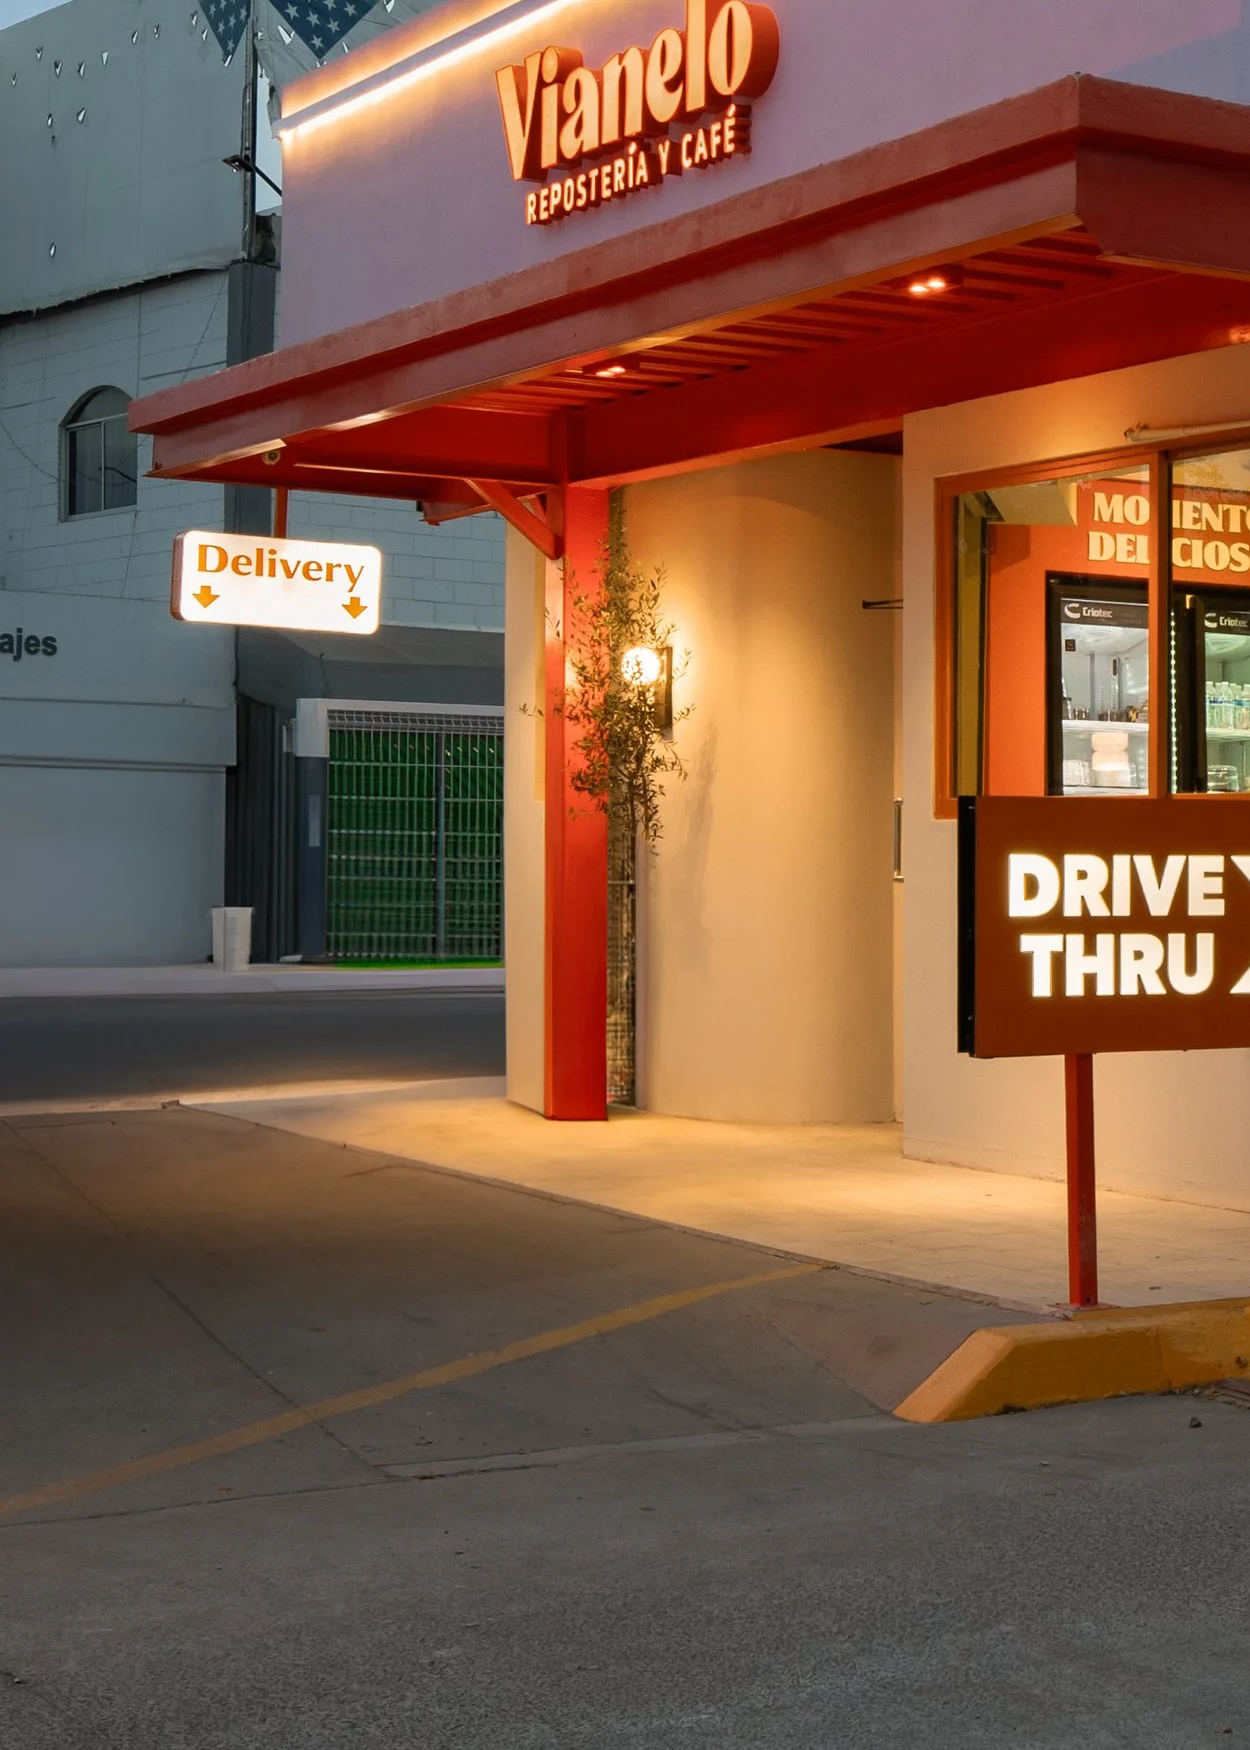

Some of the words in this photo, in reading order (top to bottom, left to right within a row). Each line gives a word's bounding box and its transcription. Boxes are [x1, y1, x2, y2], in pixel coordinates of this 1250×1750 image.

[526, 141, 649, 225] REPOSTERÍA
[658, 139, 671, 175] Y
[681, 103, 737, 169] CAFÉ
[197, 544, 365, 593] Delivery
[1008, 853, 1226, 918] DRIVE
[1019, 932, 1215, 998] THRU
